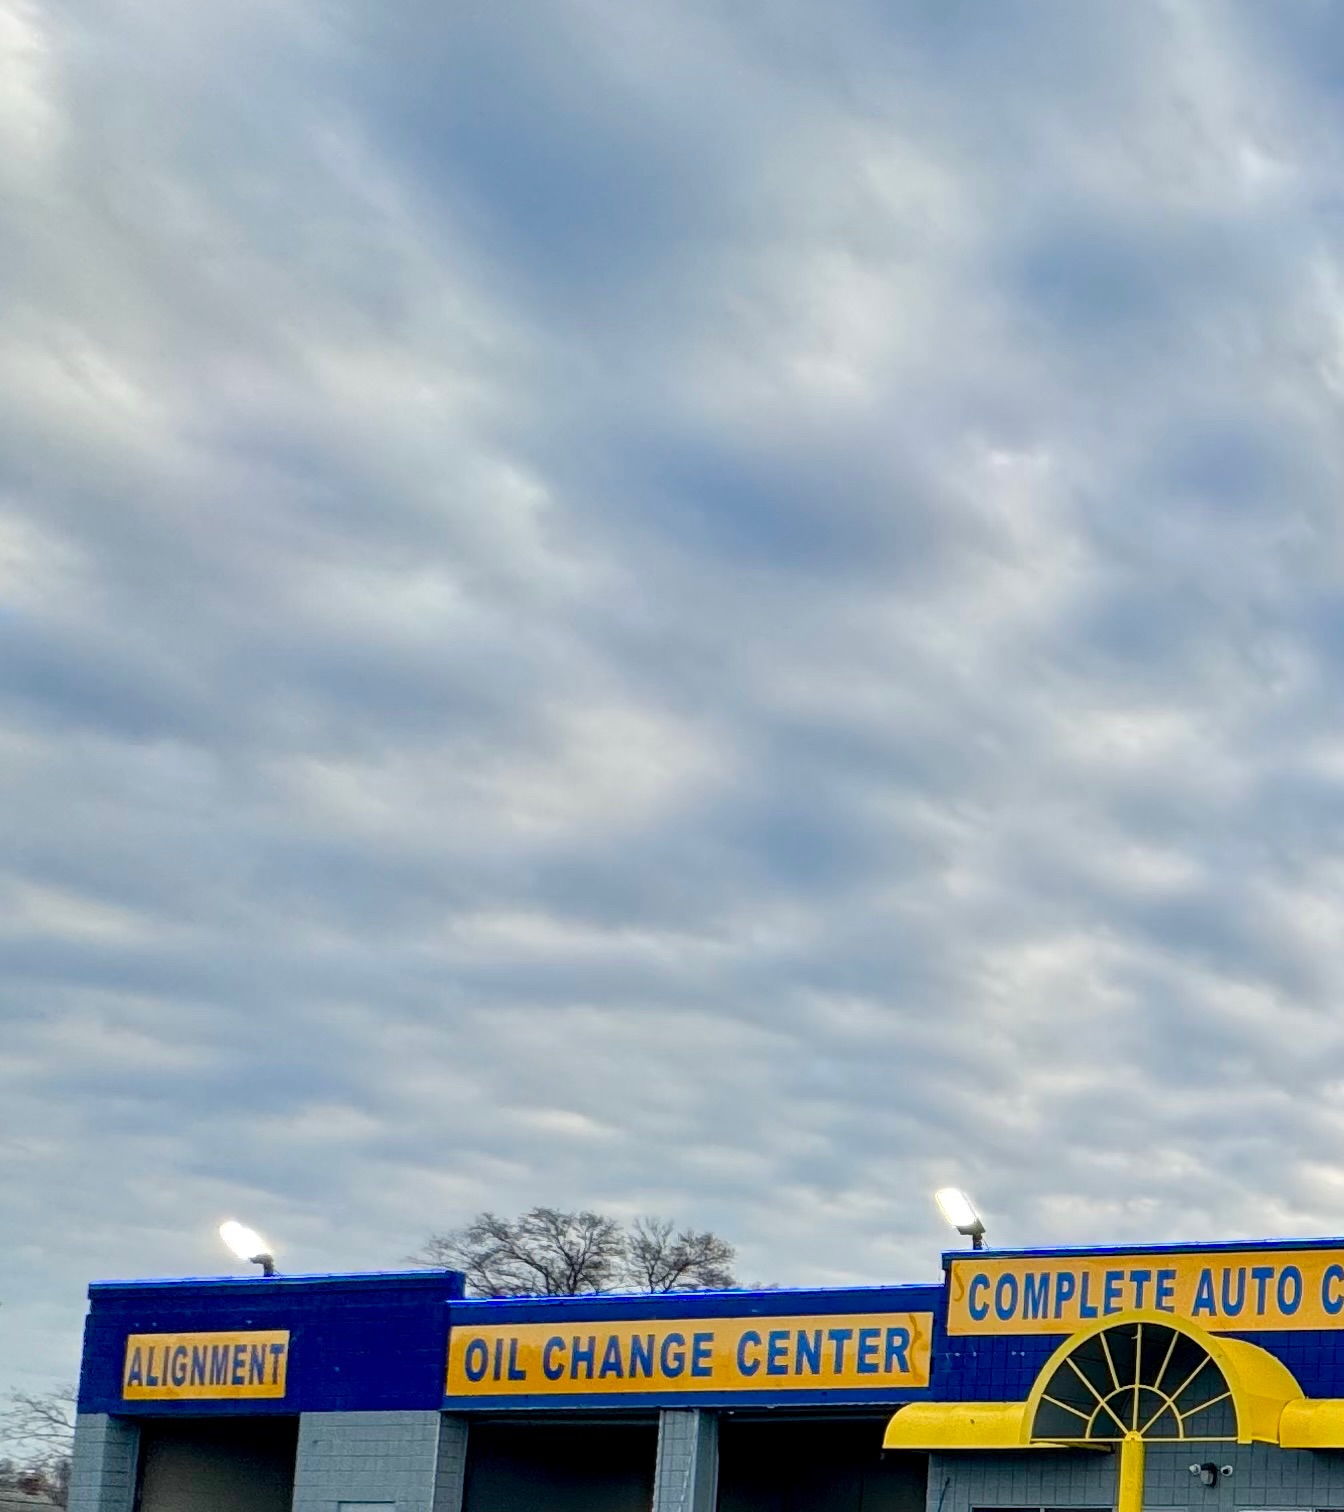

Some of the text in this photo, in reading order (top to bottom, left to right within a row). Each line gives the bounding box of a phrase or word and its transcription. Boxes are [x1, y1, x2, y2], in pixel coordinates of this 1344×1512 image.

[967, 1268, 1177, 1322] COMPLETE
[1191, 1265, 1303, 1318] AUTO
[126, 1343, 286, 1388] ALIGNMENT
[463, 1326, 912, 1384] OIL CHANGE CENTER
